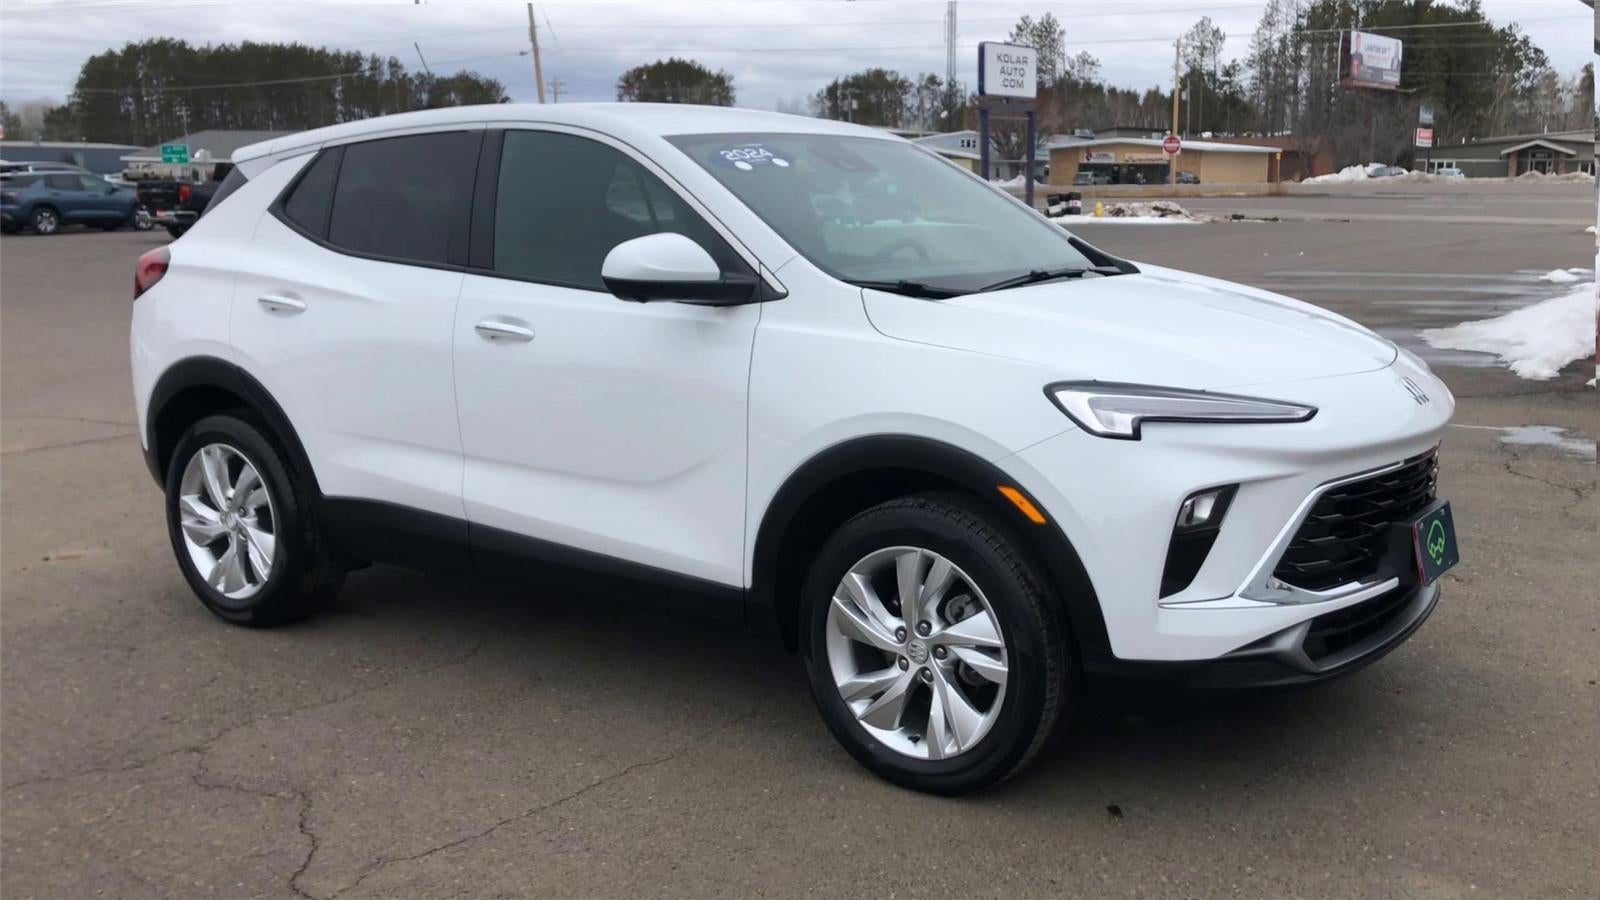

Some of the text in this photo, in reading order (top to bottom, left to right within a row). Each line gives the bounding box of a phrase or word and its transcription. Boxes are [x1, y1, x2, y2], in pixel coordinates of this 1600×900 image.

[996, 54, 1028, 65] KOLAR
[1000, 66, 1025, 77] AUTO
[1000, 78, 1024, 89] .COM
[720, 148, 774, 160] 2024
